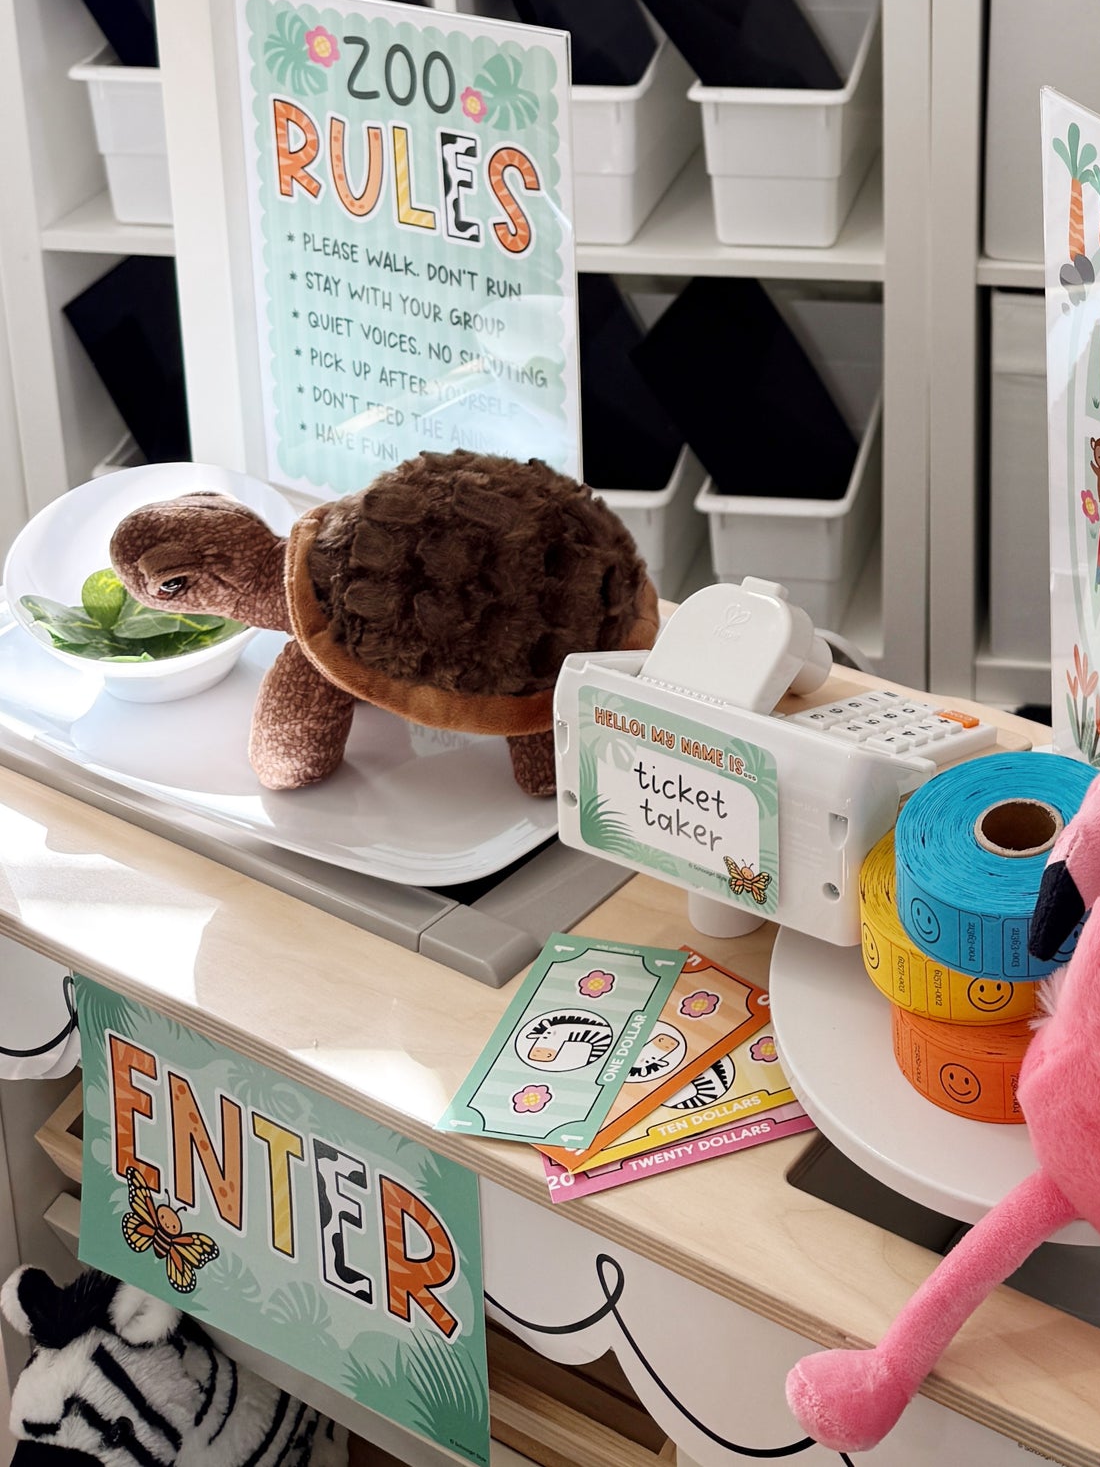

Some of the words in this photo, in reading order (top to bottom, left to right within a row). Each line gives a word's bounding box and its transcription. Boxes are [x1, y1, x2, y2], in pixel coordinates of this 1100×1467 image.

[343, 35, 456, 114] ZOO
[273, 99, 540, 253] RULES
[303, 232, 359, 264] PLEASE
[366, 248, 420, 277] WALK.
[427, 263, 478, 291] DON'T
[486, 277, 521, 300] RUN
[305, 272, 341, 298] STAY
[349, 282, 392, 312] WITH
[399, 293, 442, 323] YOUR
[450, 308, 505, 332] GROUP
[308, 311, 354, 338] QUIET
[361, 324, 421, 356] VOICES.
[429, 343, 452, 364] NO
[459, 350, 548, 389] SHOUTING
[310, 348, 345, 372] PICK
[352, 360, 371, 380] UP
[379, 367, 428, 397] AFTER
[433, 380, 523, 417] YOURSELF
[313, 386, 359, 414] DON'T
[366, 401, 404, 426] FEED
[412, 412, 443, 440] THE
[315, 422, 354, 451] HAVE
[595, 707, 645, 740] HELLO!
[651, 725, 675, 749] MY
[681, 737, 723, 768] NAME
[633, 761, 728, 819] ticket
[640, 798, 723, 851] taker
[602, 1054, 624, 1082] ONE
[615, 1014, 647, 1057] DOLLAR
[657, 1120, 688, 1137] TEN
[691, 1095, 761, 1126] DOLLARS
[108, 1033, 458, 1339] ENTER
[546, 1172, 575, 1190] 20
[629, 1144, 694, 1171] TWENTY
[698, 1123, 771, 1151] DOLLARS
